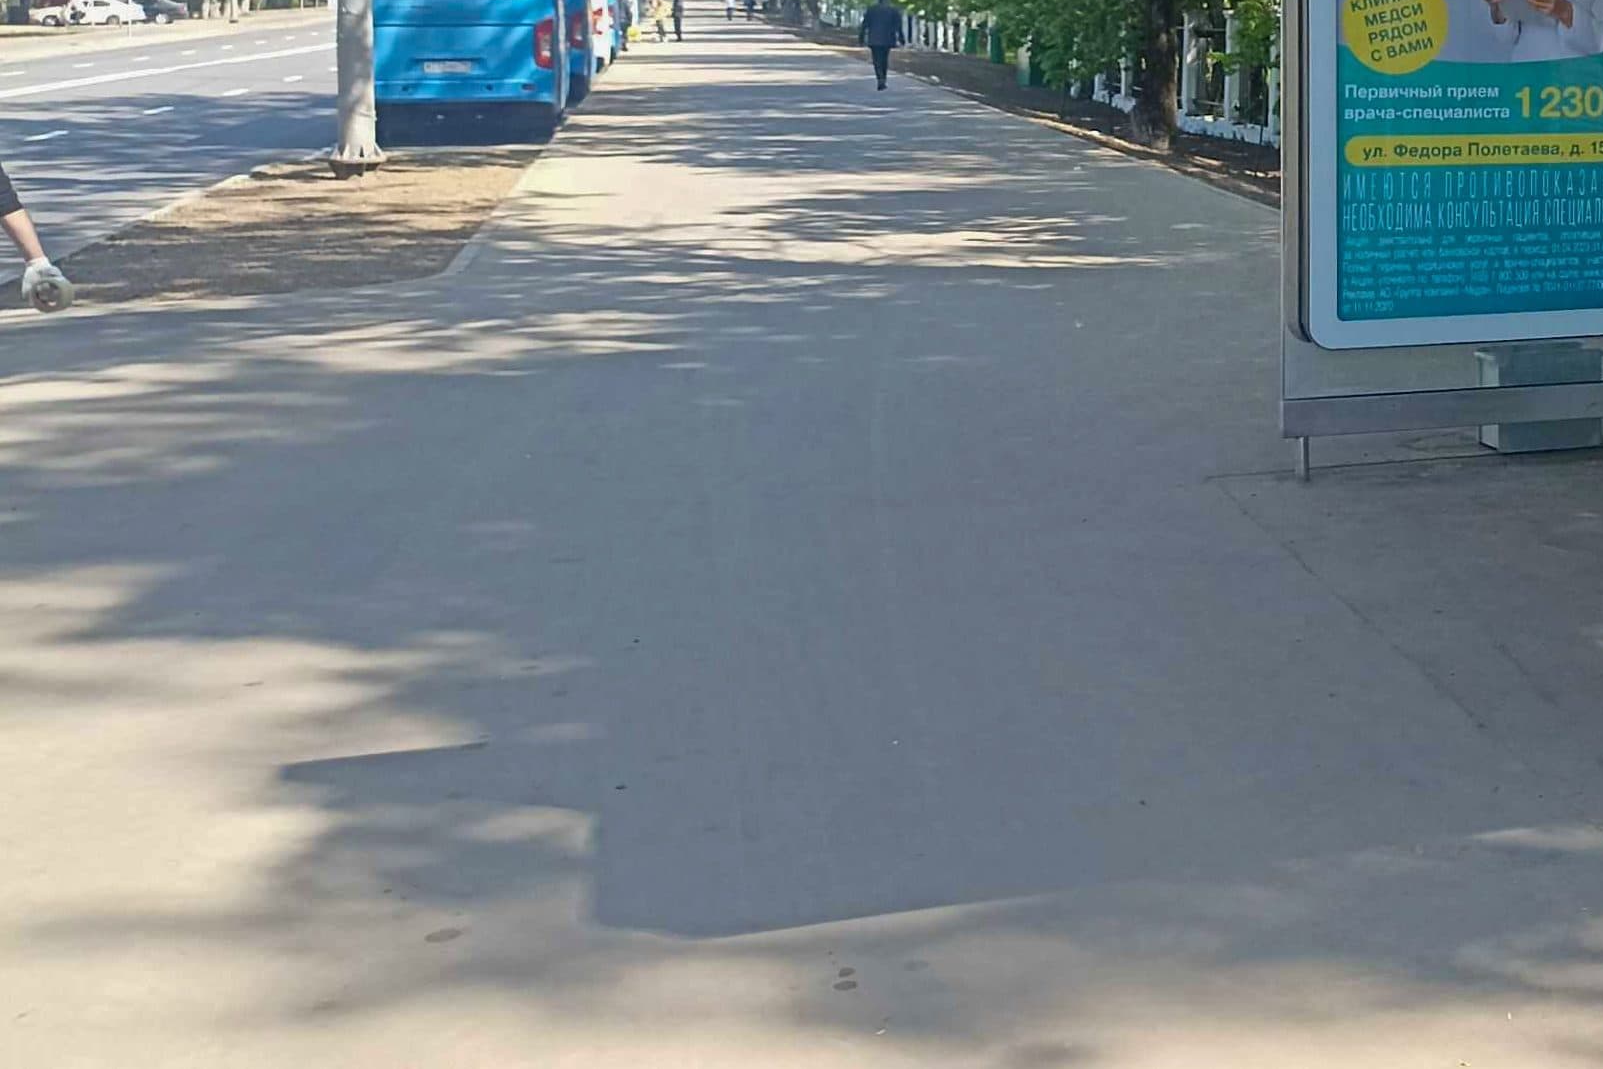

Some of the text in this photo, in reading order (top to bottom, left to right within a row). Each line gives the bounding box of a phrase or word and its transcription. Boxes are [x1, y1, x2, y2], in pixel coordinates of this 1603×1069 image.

[1364, 3, 1424, 27] МЕДСИ
[1368, 20, 1428, 44] РЯДОМ
[1370, 36, 1434, 62] С ВАМИ
[1344, 83, 1500, 102] Первичный прием
[1343, 105, 1511, 122] врача-специалиста
[1363, 145, 1388, 161] ул.
[1393, 142, 1463, 159] Федора
[1467, 141, 1565, 158] Полетаева,
[1569, 143, 1585, 157] д.
[1343, 171, 1431, 201] ИМЕЮТСЯ
[1342, 201, 1433, 232] НЕОБХОДИМА
[1438, 198, 1540, 229] КОНСУЛЬТАЦИЯ
